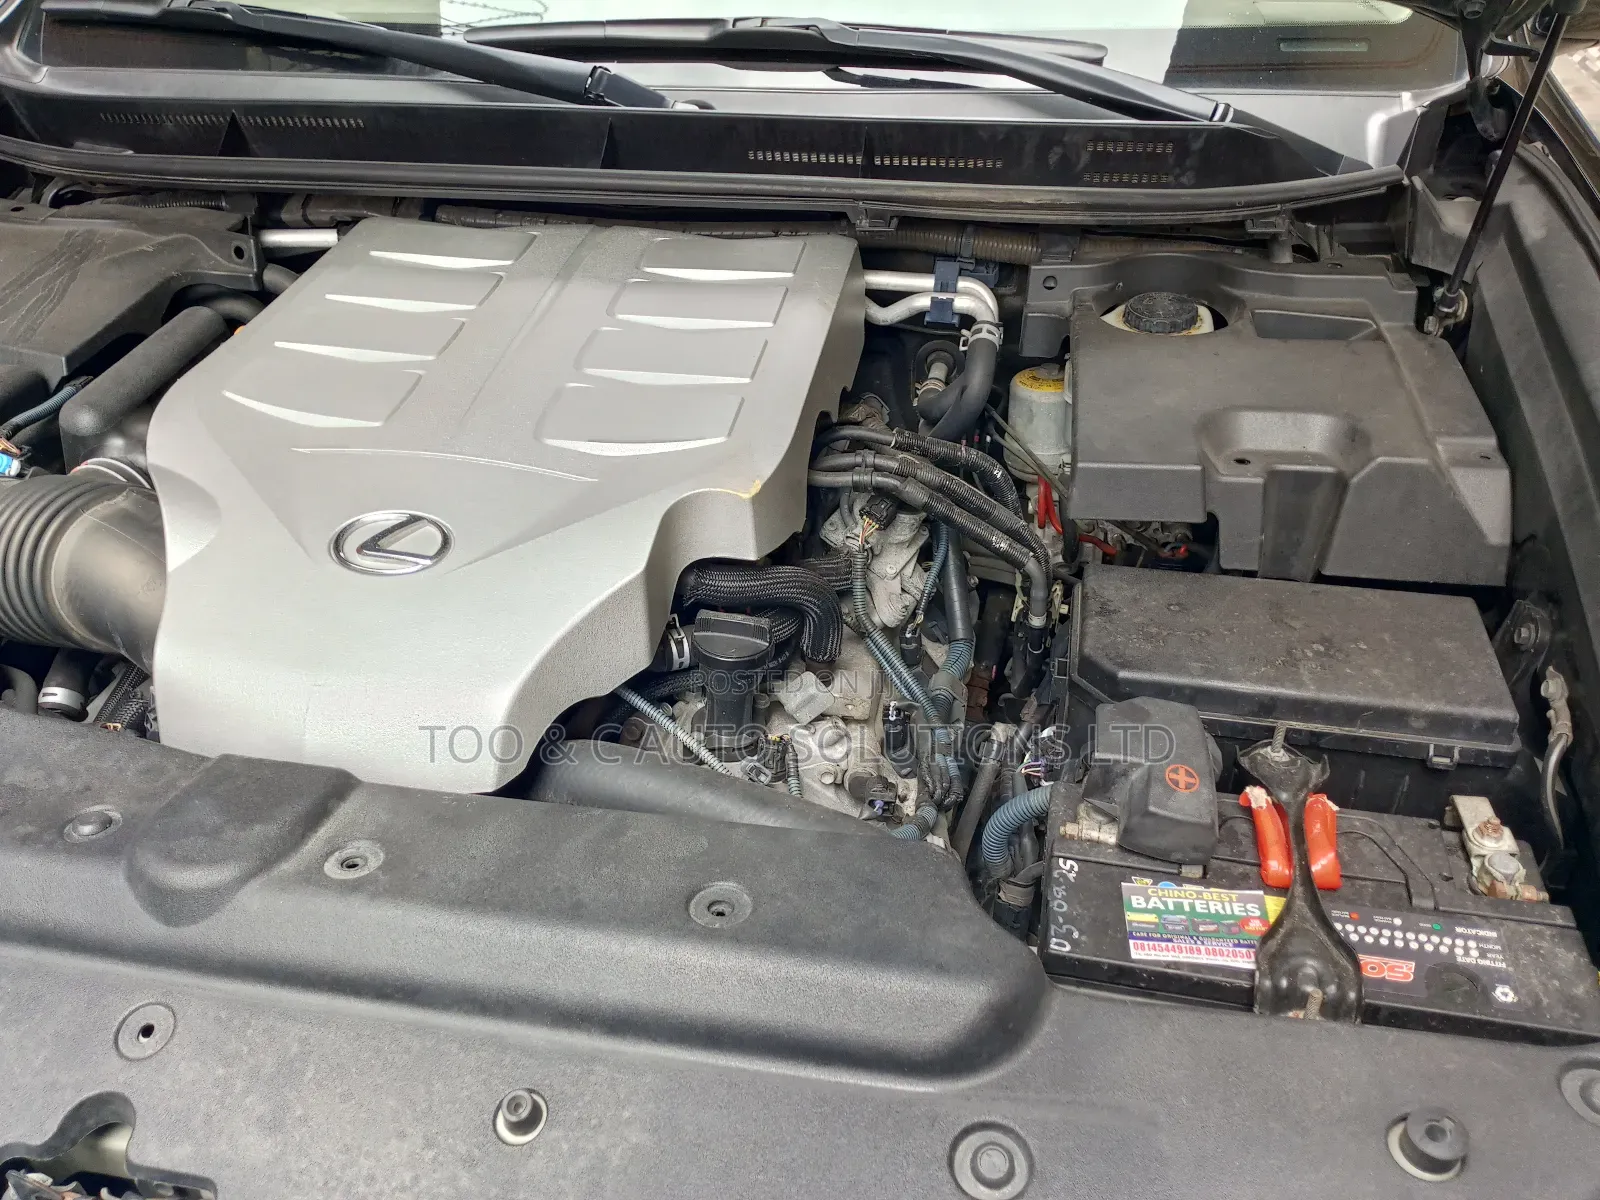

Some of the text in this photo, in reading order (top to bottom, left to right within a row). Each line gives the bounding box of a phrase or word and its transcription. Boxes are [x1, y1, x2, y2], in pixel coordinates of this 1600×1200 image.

[1147, 888, 1239, 902] CHINO-BEST
[1130, 895, 1261, 917] BATTERIES
[1455, 926, 1498, 938] INDICATOR
[1478, 942, 1502, 950] MONTH
